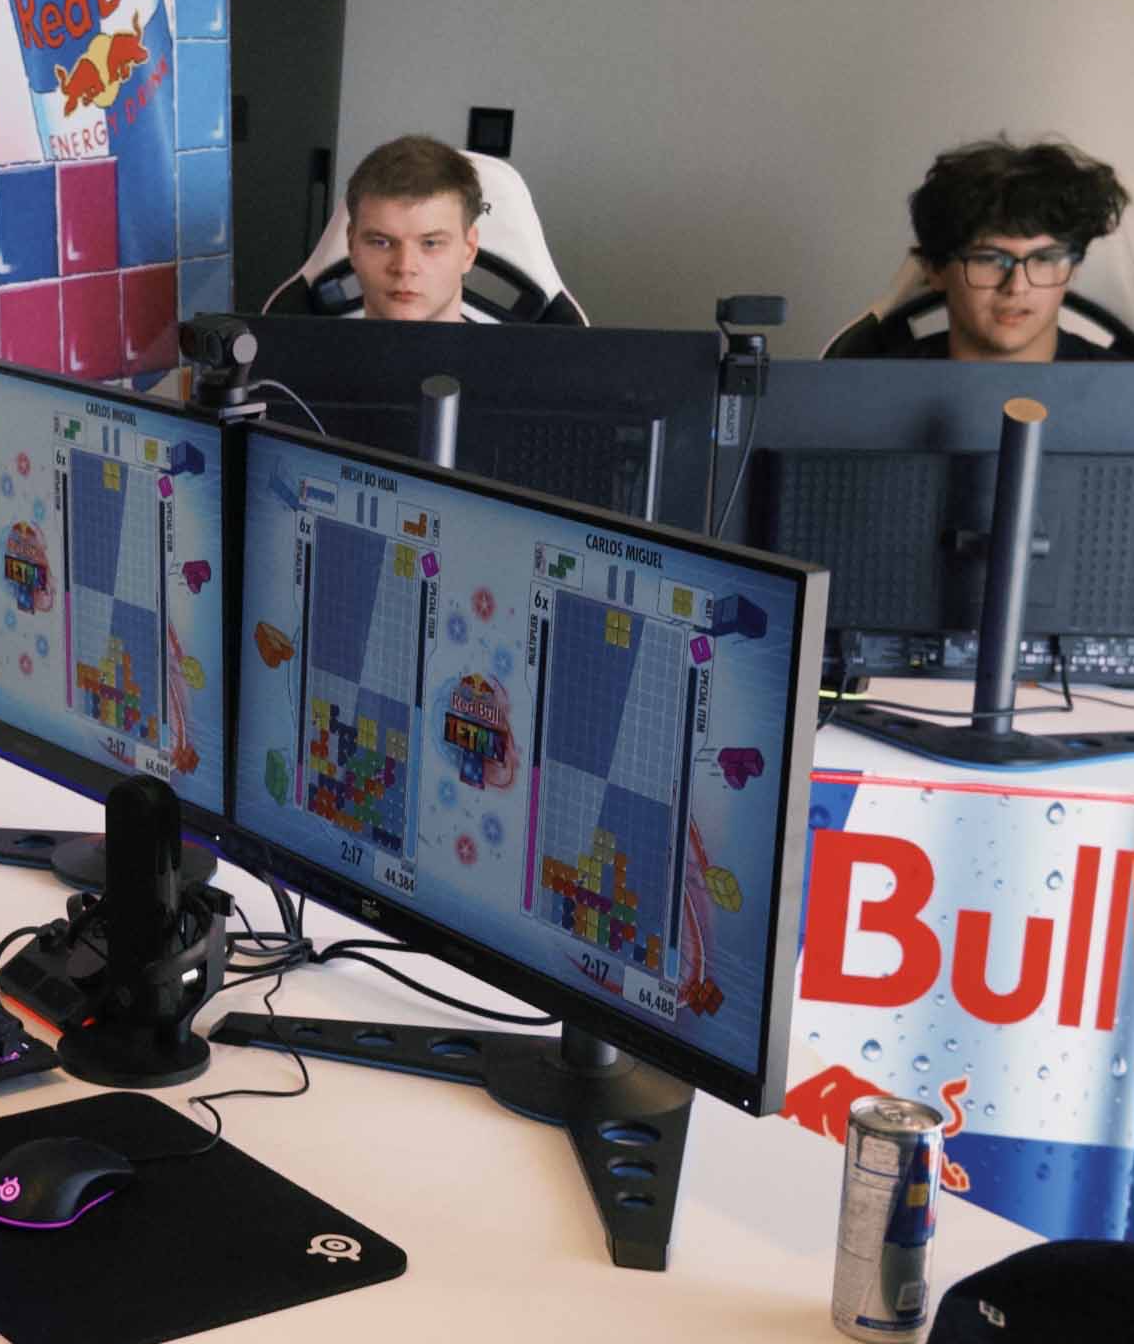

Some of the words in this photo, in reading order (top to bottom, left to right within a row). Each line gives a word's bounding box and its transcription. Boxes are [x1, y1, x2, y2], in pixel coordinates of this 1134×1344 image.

[585, 533, 623, 558] CARLOS
[625, 545, 664, 569] MIGUEL
[534, 590, 548, 611] 6x
[698, 668, 709, 704] SPECIAL
[697, 706, 708, 733] ITEM
[341, 840, 363, 867] 2:17
[800, 828, 1134, 1032] Bull
[582, 953, 610, 983] 2:17
[638, 987, 675, 1017] 64,488
